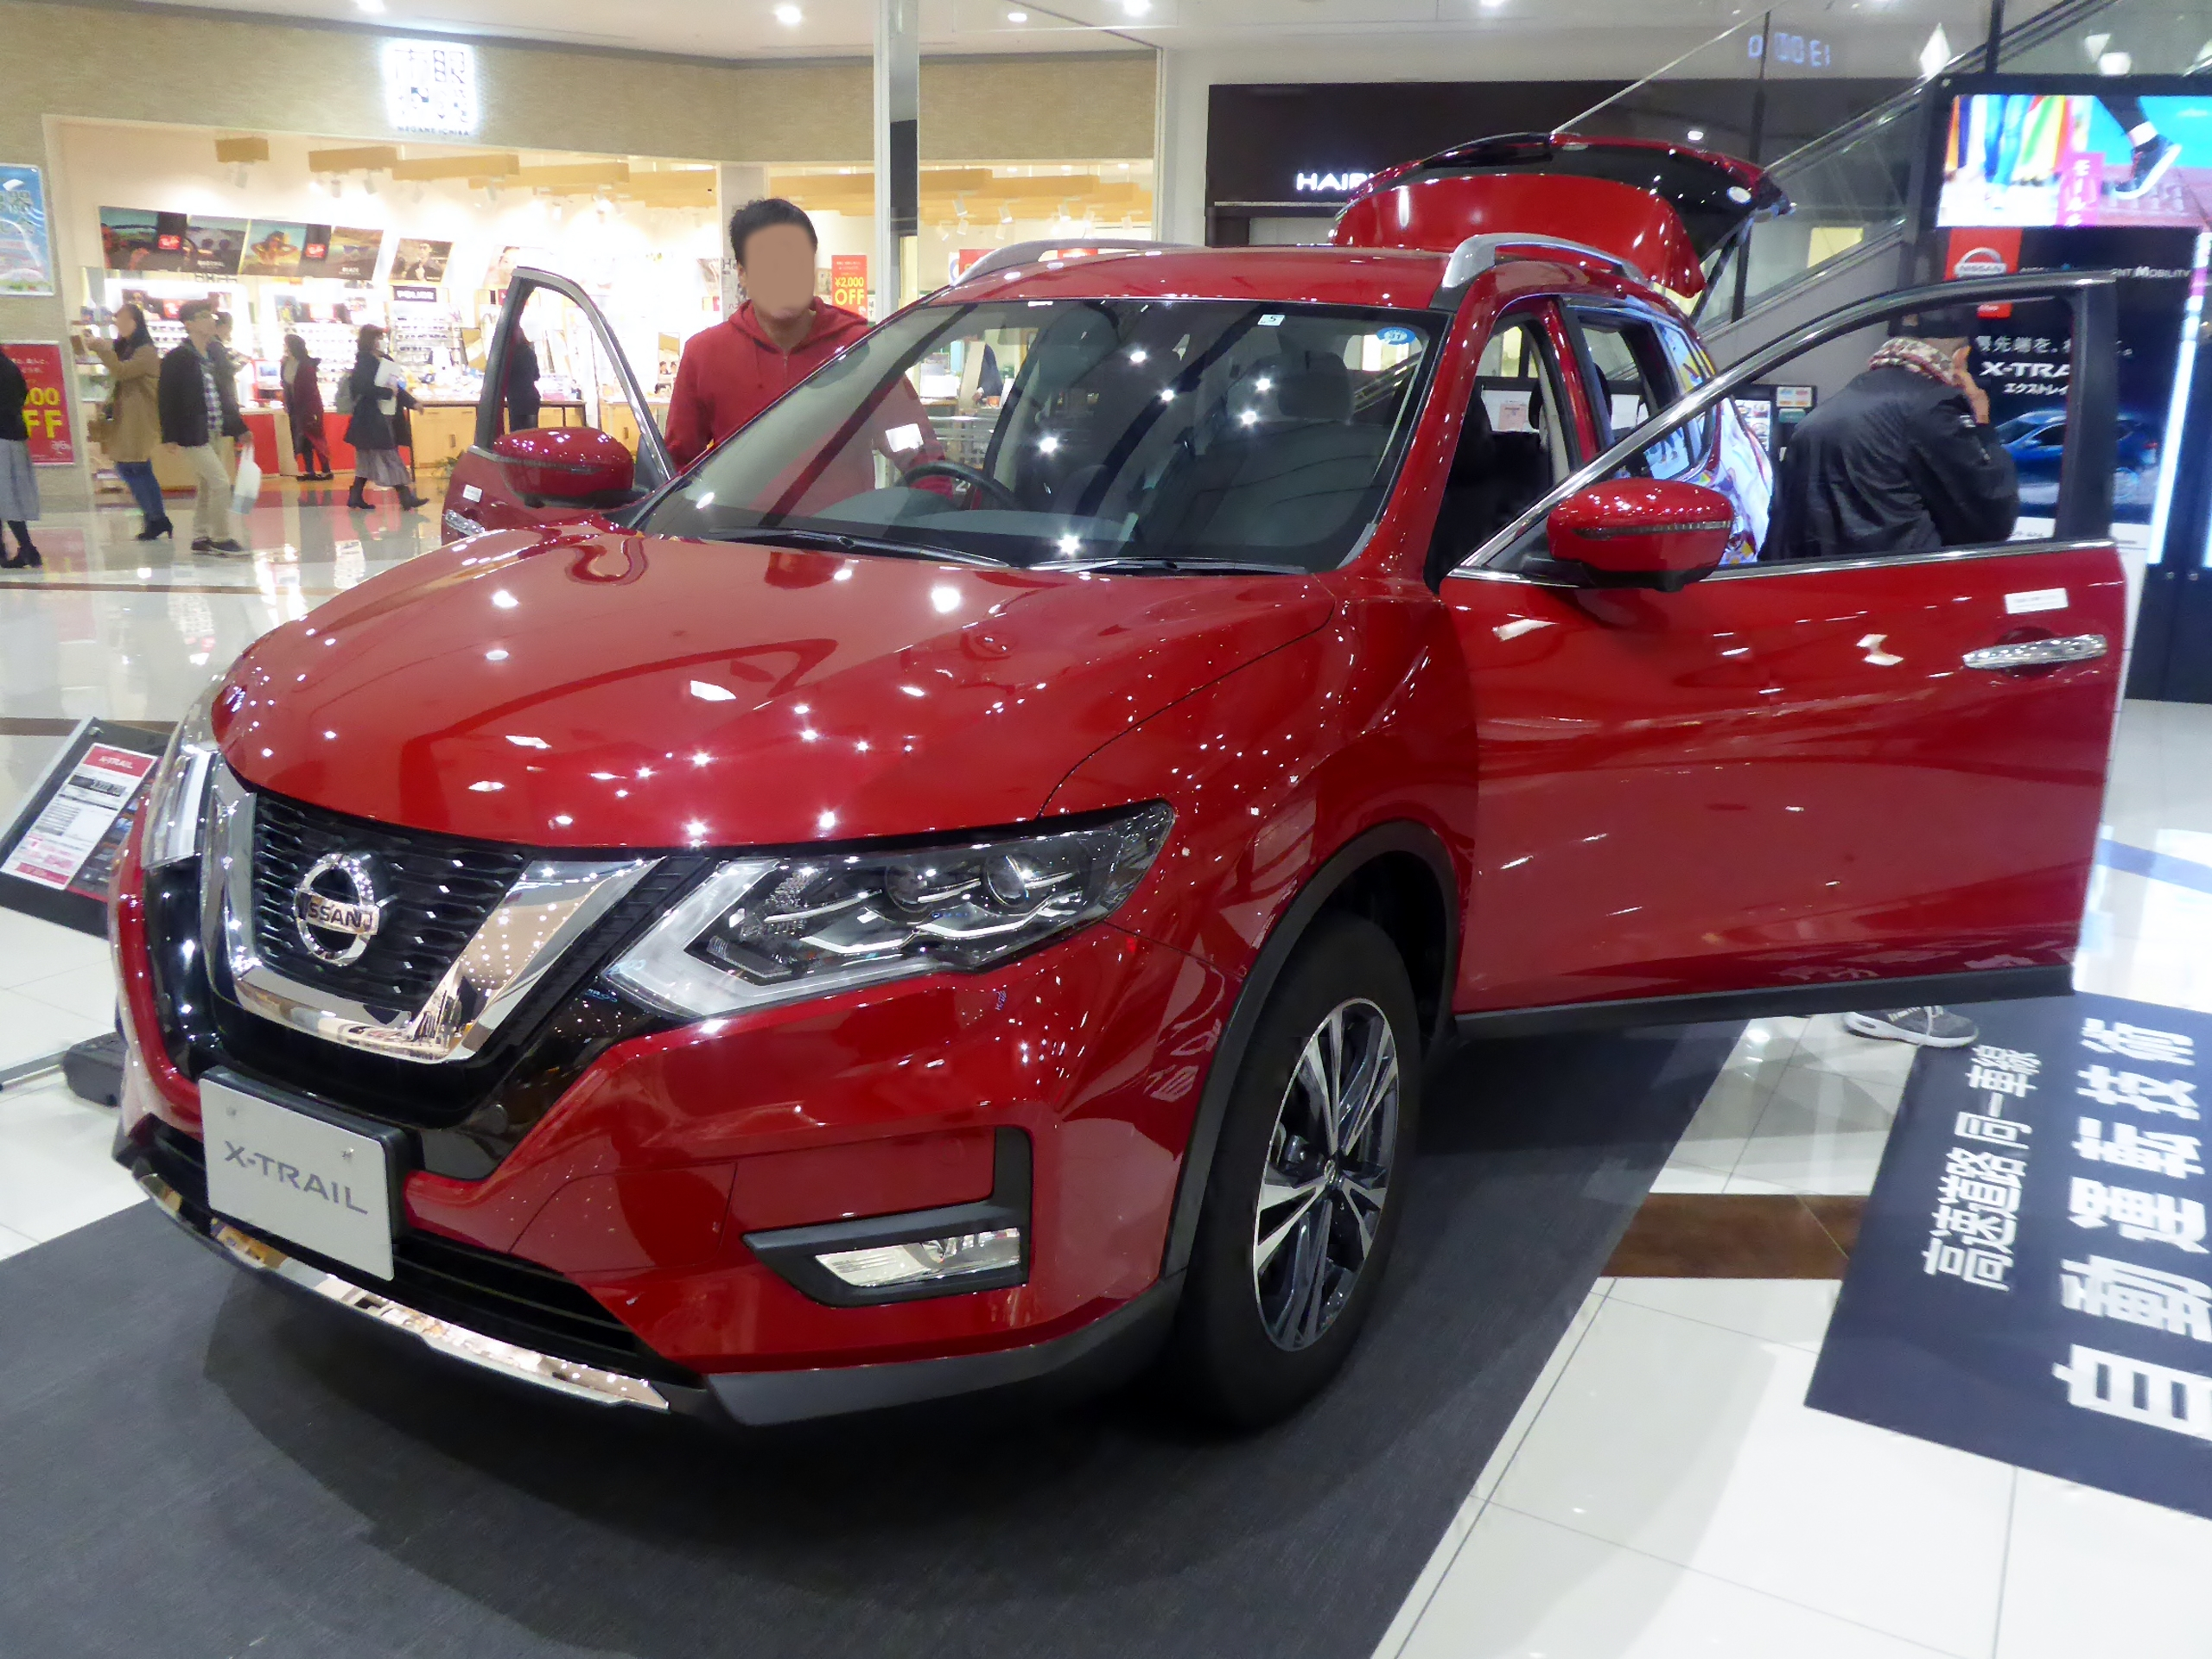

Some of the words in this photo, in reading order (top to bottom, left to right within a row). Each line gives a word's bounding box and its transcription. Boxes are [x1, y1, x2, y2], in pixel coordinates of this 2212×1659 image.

[1296, 172, 1376, 191] HAIR
[835, 276, 864, 288] ¥2,000
[835, 288, 865, 306] OFF
[1980, 361, 2070, 378] X-TRA
[2003, 382, 2069, 396] エクストレイ
[22, 409, 63, 439] FF
[298, 896, 363, 929] SSAN
[224, 1141, 368, 1215] X-TRAIL
[2052, 1017, 2212, 1442] 自動運転技術
